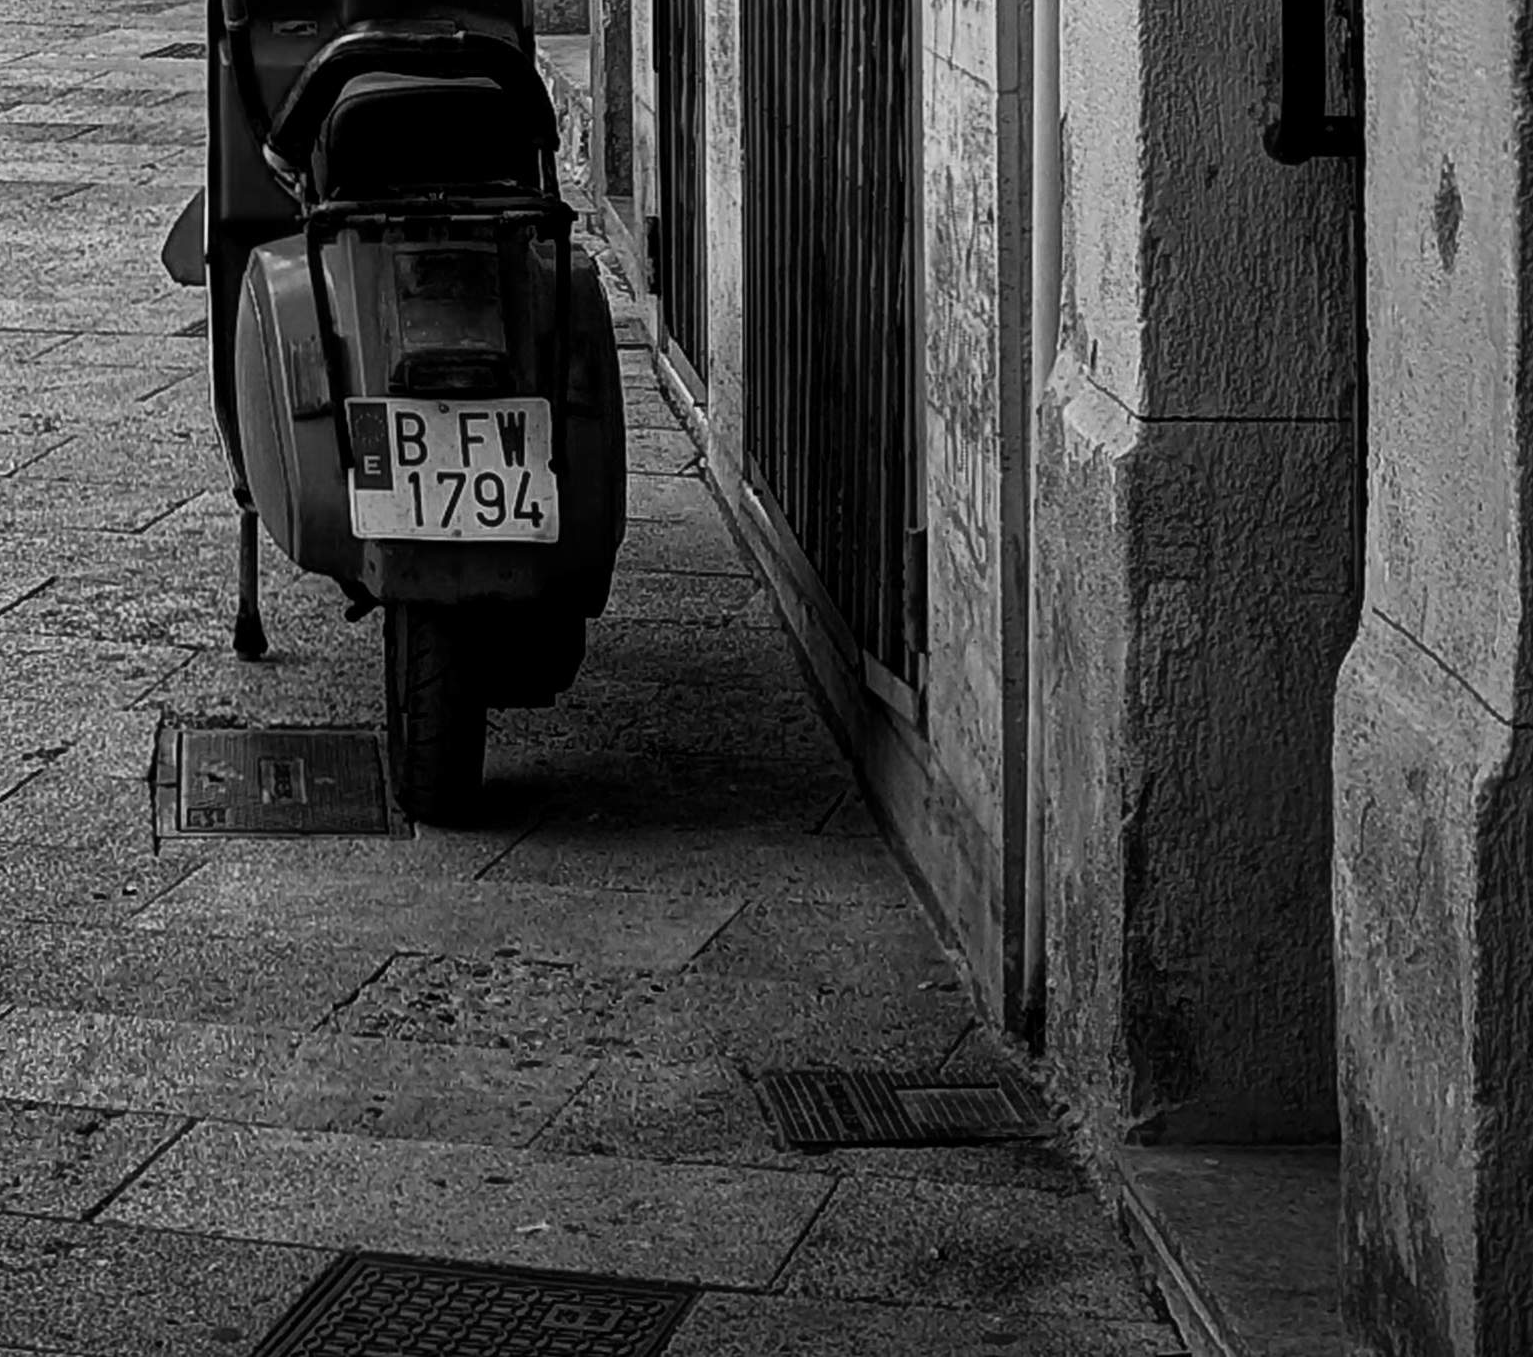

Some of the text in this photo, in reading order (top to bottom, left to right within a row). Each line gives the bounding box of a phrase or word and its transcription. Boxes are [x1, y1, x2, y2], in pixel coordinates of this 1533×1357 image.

[363, 455, 382, 475] E
[395, 411, 526, 468] B FW
[408, 471, 544, 528] 1794
